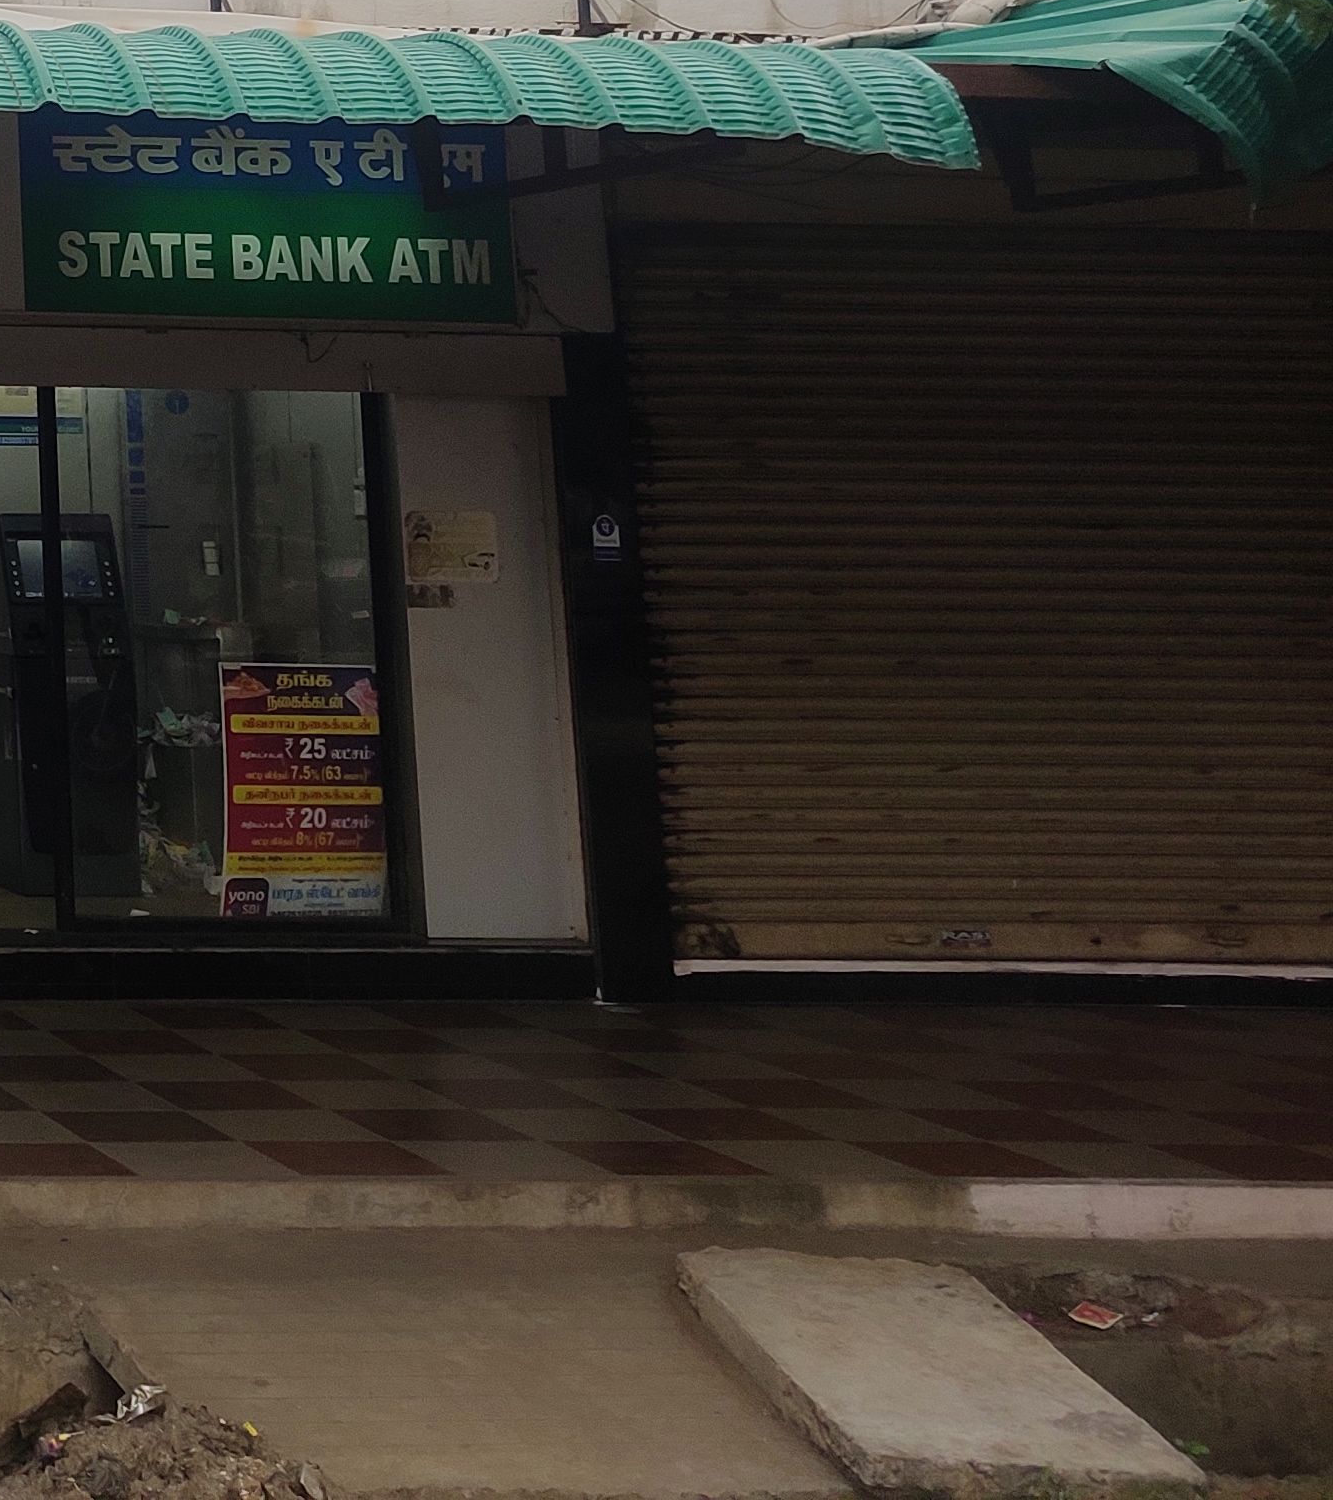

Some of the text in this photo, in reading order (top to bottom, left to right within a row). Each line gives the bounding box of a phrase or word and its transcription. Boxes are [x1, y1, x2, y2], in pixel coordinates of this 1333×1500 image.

[52, 124, 182, 174] स्टेट
[190, 125, 292, 176] बैंक
[353, 128, 408, 182] टी
[57, 231, 492, 286] STATE BANK ATM
[276, 670, 333, 690] தங்க
[299, 737, 326, 760] 25
[300, 807, 326, 828] 20
[228, 891, 265, 903] yono
